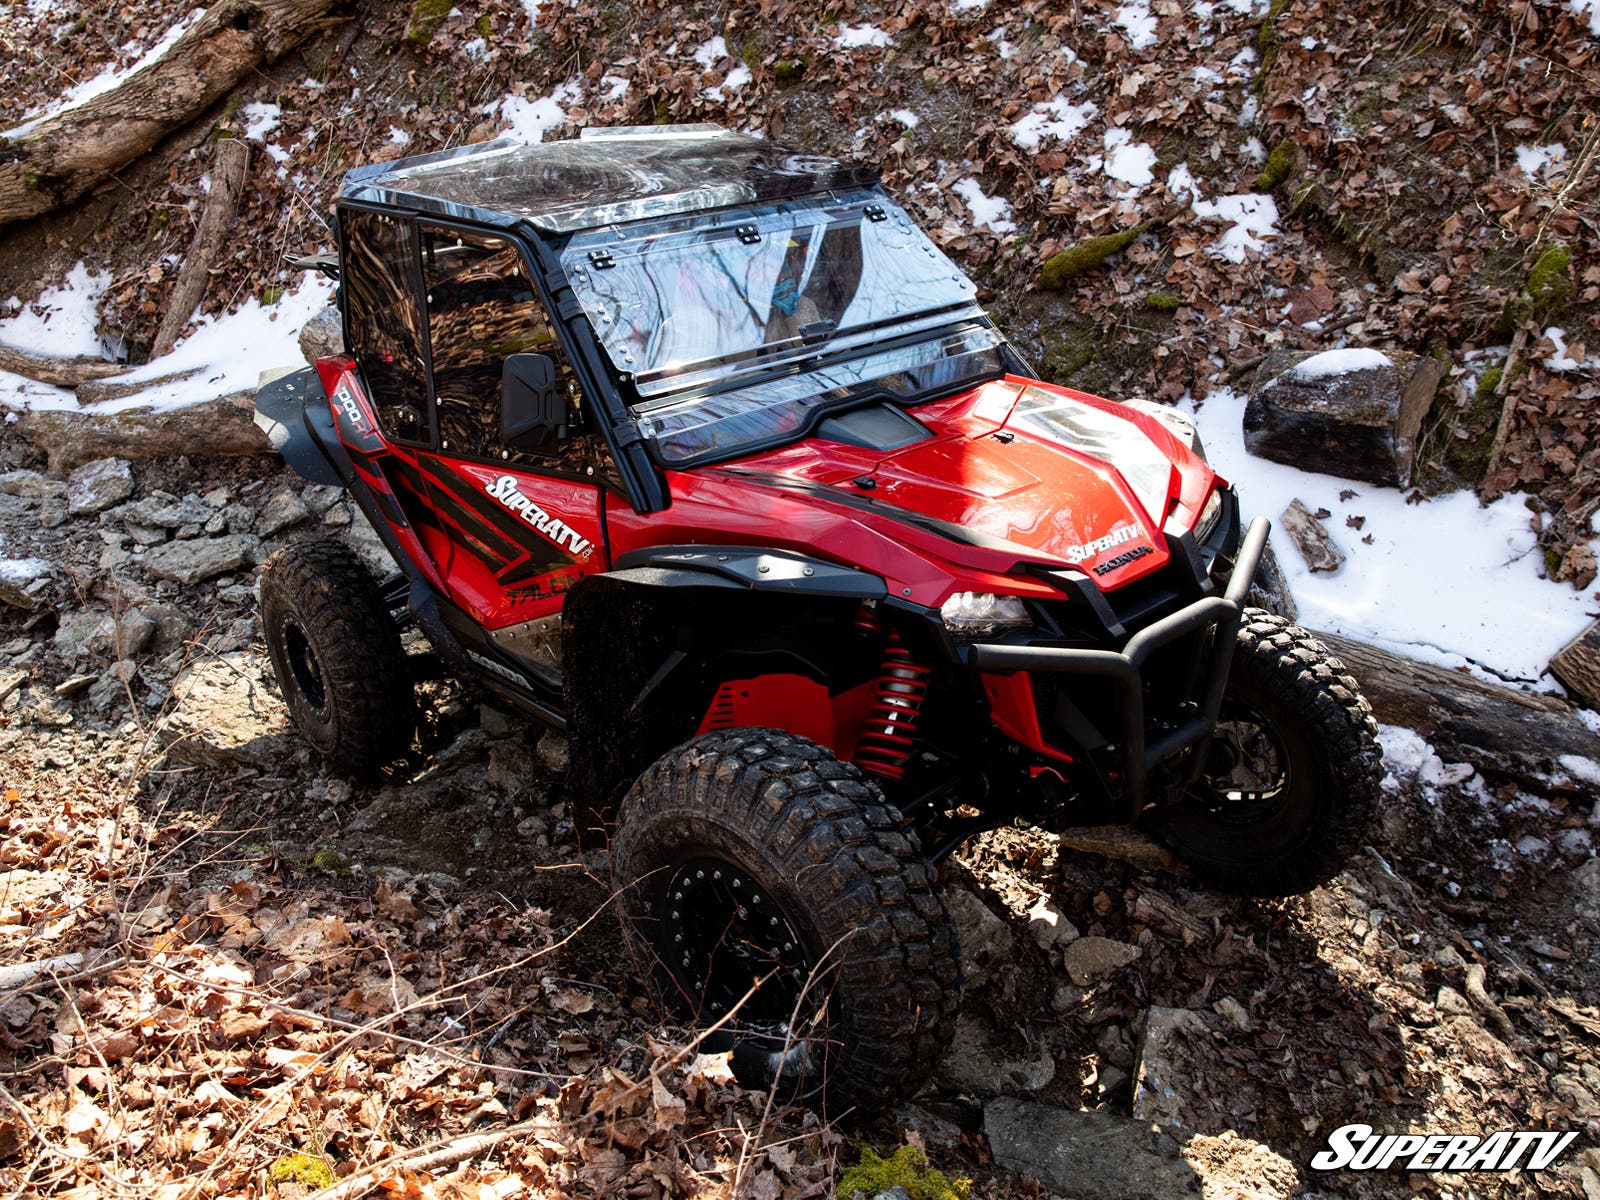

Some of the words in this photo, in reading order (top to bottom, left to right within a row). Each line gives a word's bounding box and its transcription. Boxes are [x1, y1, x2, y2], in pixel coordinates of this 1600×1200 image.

[485, 475, 590, 554] SUPERATV
[1066, 523, 1141, 563] SUPERATV
[1092, 545, 1153, 576] HONDA
